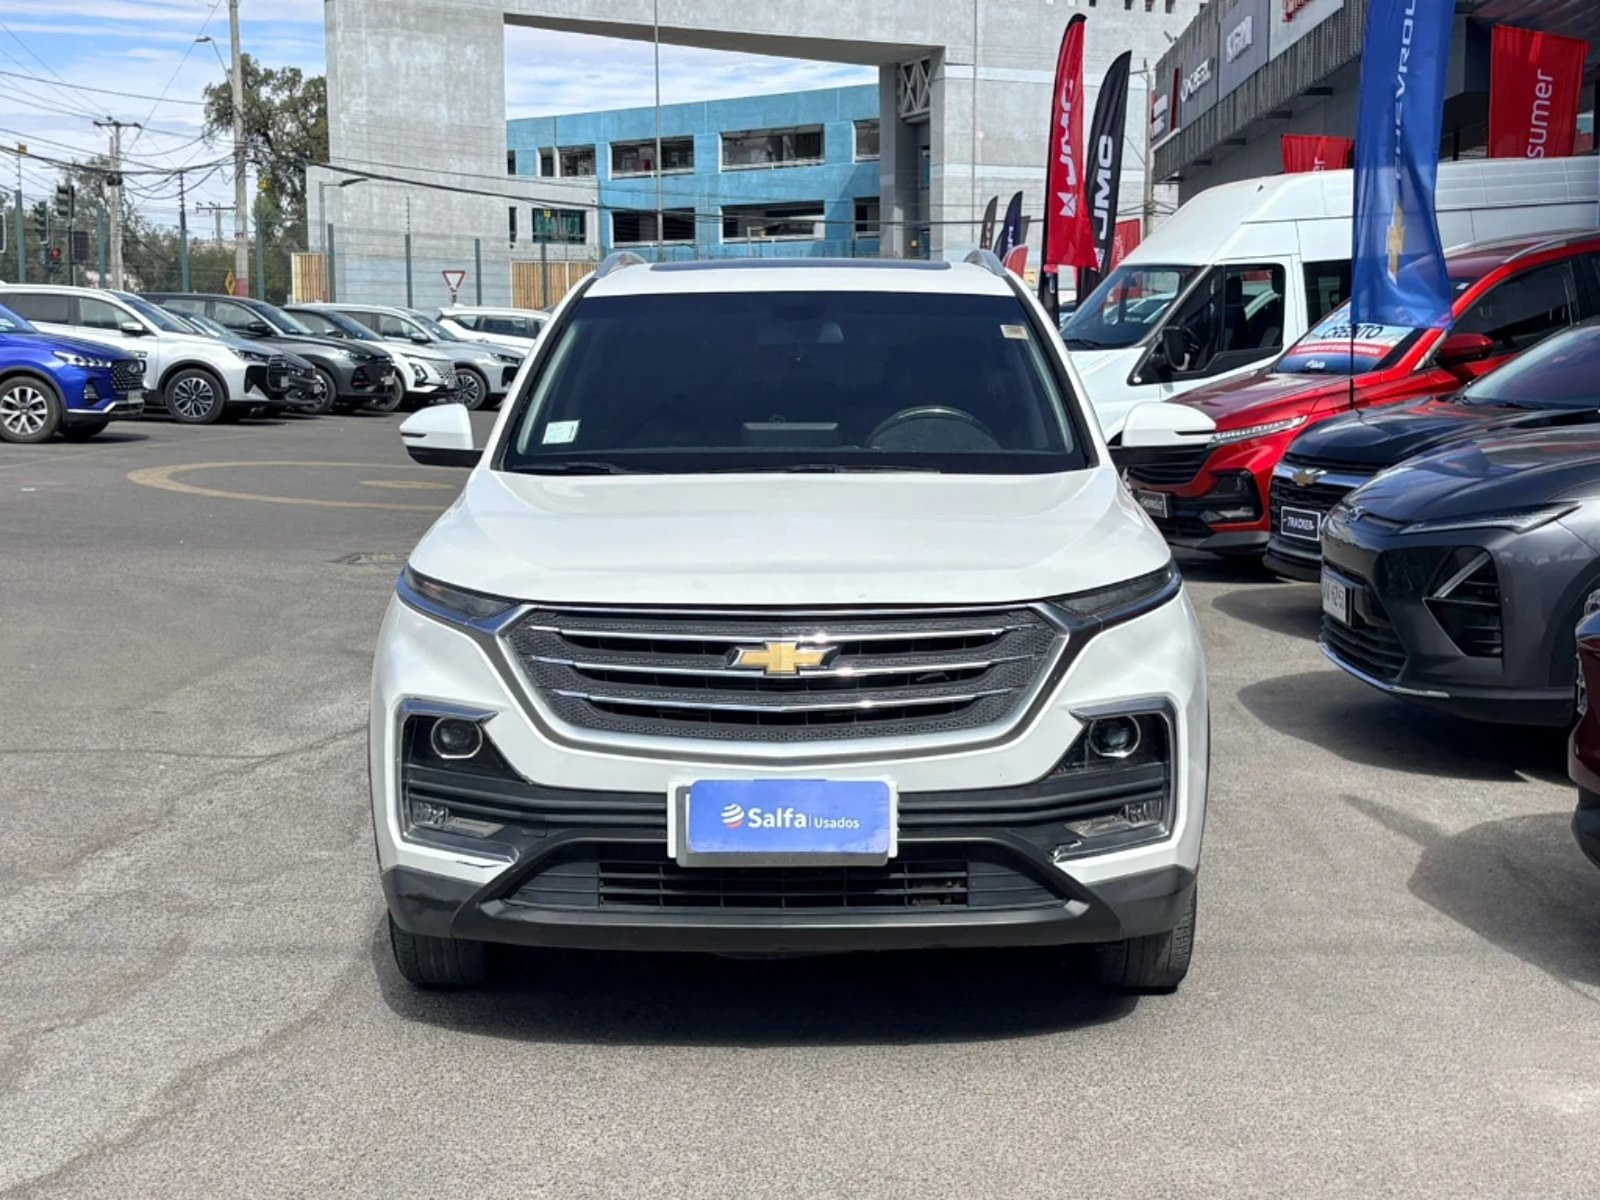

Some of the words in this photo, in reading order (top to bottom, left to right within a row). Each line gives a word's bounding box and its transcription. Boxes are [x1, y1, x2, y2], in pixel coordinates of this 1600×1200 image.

[1527, 68, 1554, 160] sumer
[1093, 134, 1114, 241] JMC
[748, 807, 807, 829] Salfa
[813, 816, 860, 829] Usados
